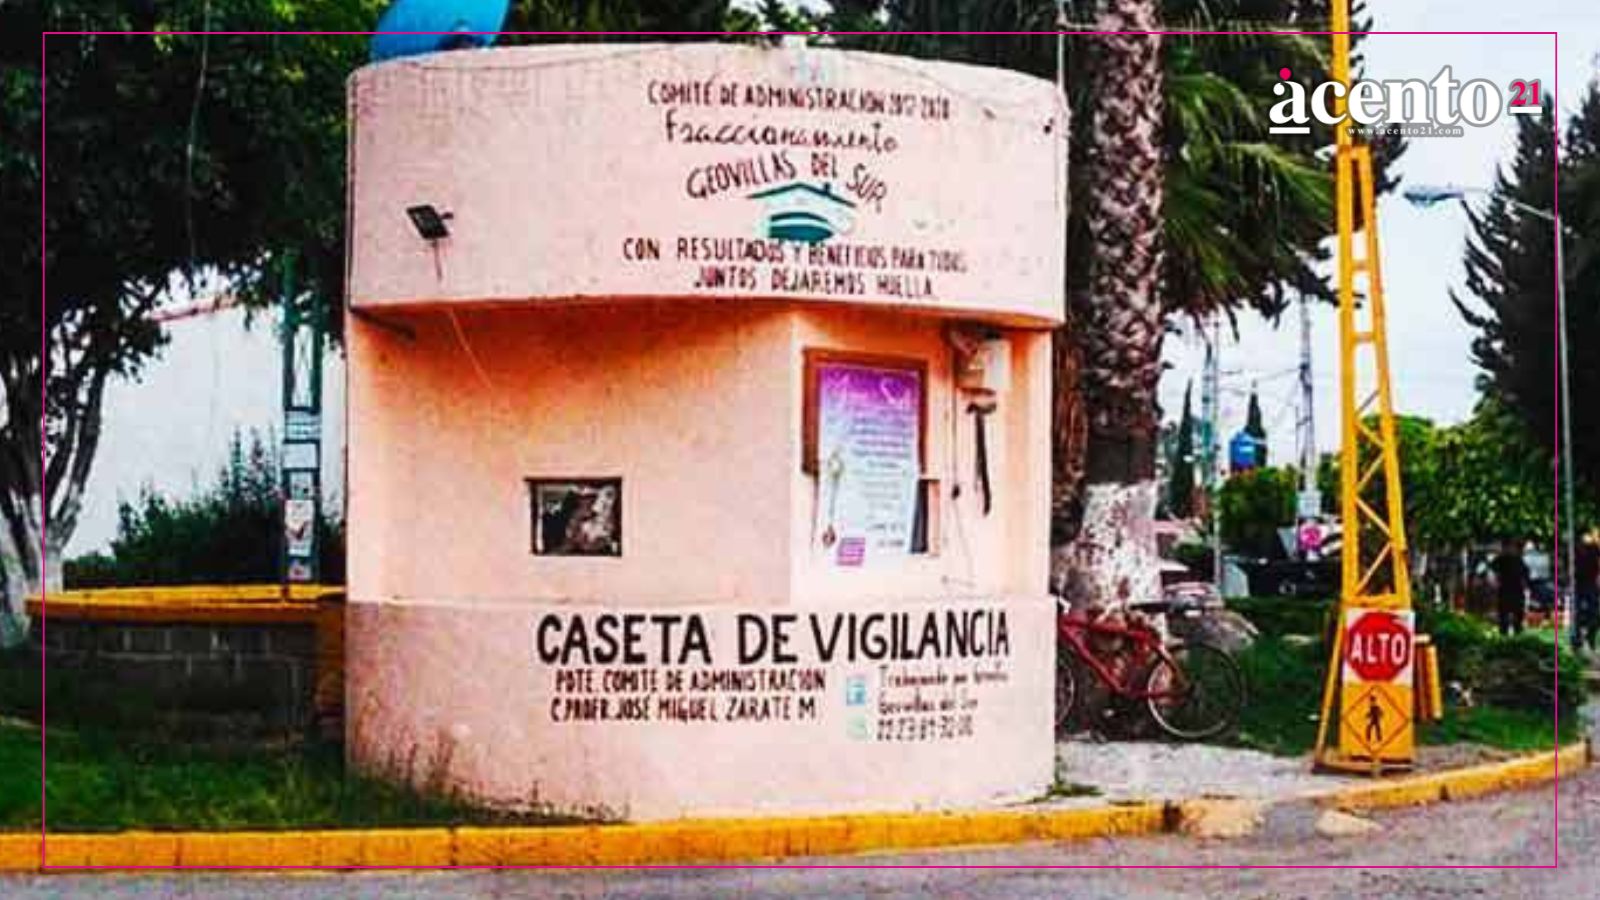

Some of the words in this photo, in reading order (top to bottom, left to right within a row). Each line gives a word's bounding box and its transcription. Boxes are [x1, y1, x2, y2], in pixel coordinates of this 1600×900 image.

[647, 79, 712, 106] COMITÉ
[719, 81, 741, 107] DE
[686, 150, 797, 199] GEOVILLAS
[811, 152, 838, 179] DEL
[846, 163, 888, 211] SUR
[623, 237, 660, 261] CON
[676, 237, 785, 265] RESULTADOS
[694, 266, 757, 290] JUNTOS
[771, 272, 866, 296] DEJAREMOS
[537, 614, 712, 665] CASETA
[737, 613, 798, 665] DE
[809, 609, 1009, 662] VIGILANCIA
[1350, 632, 1407, 666] ALTO
[666, 669, 684, 694] DE
[658, 698, 718, 723] MIGUEL
[725, 696, 791, 722] ZARATE
